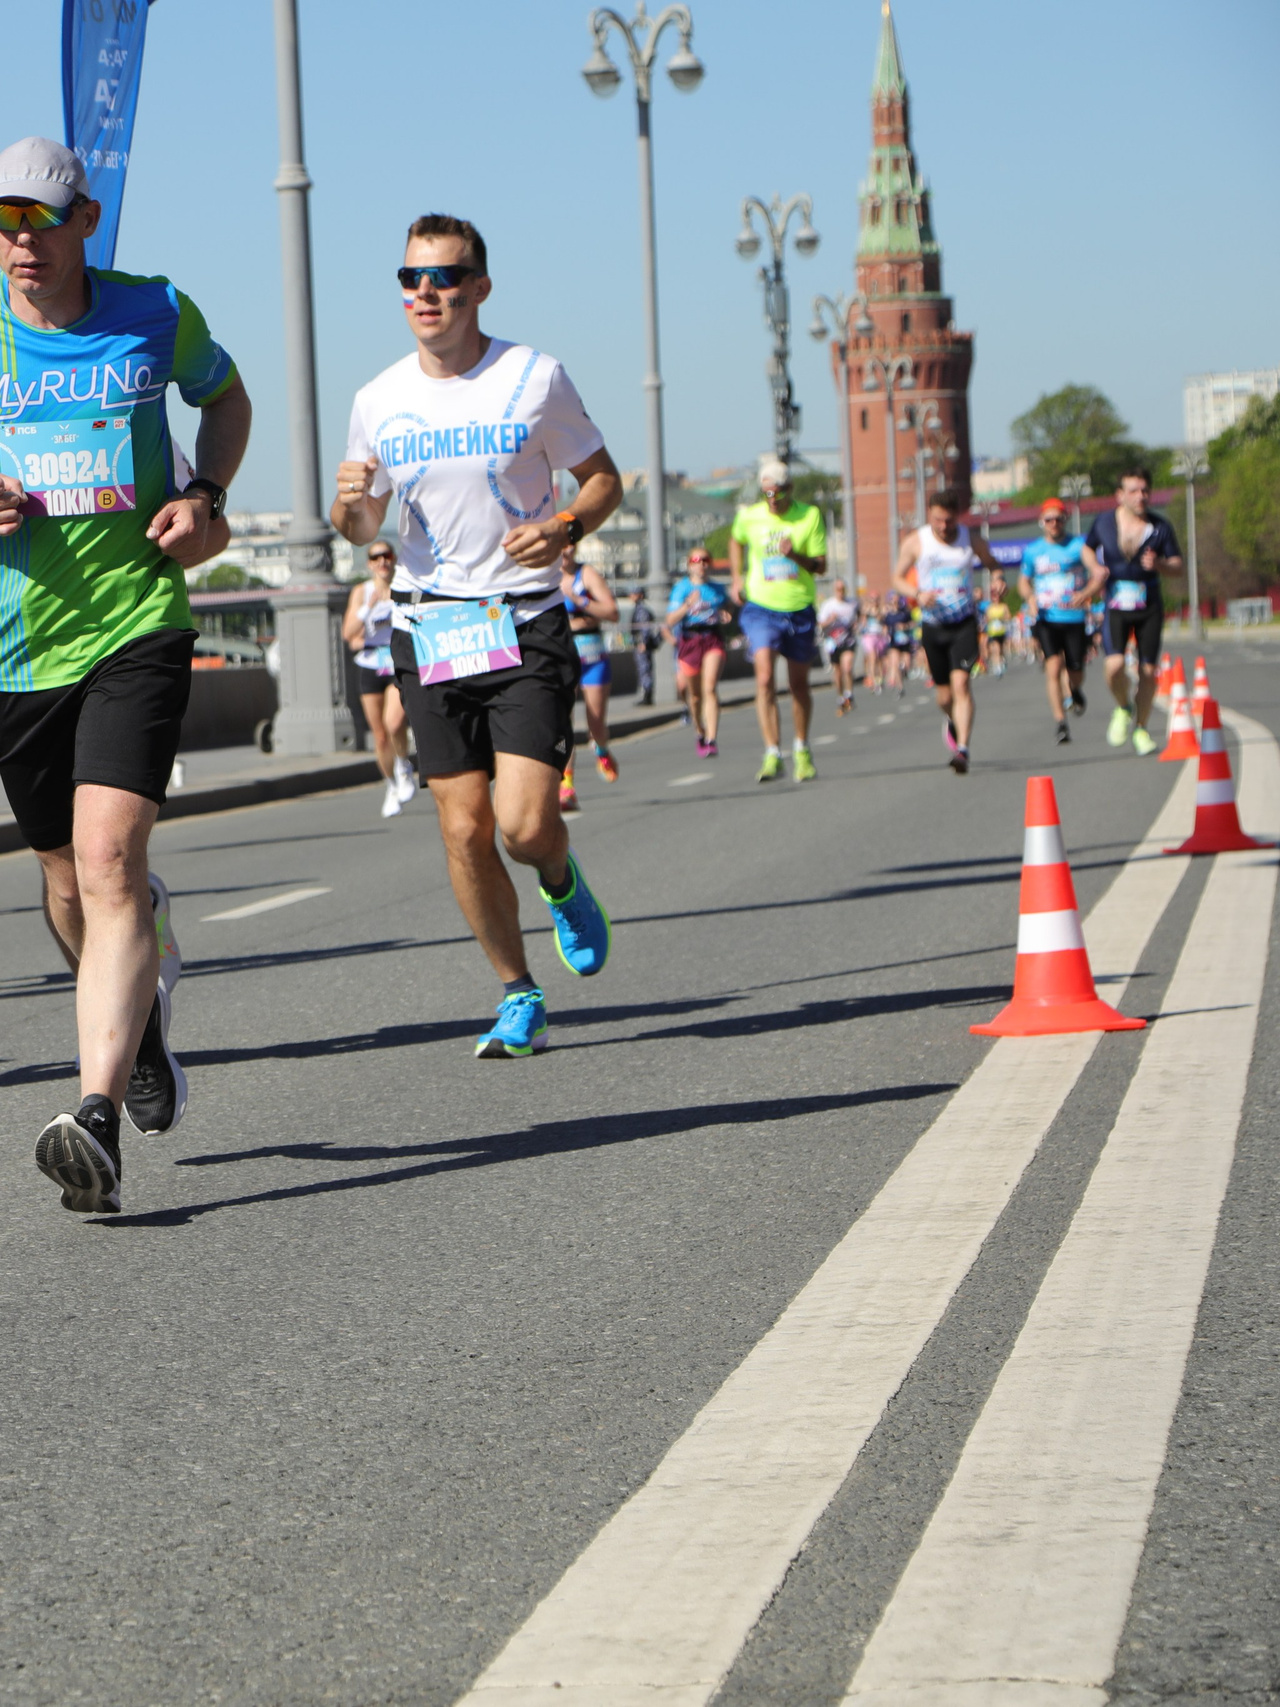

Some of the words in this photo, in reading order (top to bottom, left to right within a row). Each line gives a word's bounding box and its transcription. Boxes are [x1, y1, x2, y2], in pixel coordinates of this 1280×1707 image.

[17, 426, 37, 434] ПСБ
[380, 420, 529, 469] ПЕЙСМЕЙКЕР
[24, 448, 110, 487] 30924
[435, 621, 497, 658] 36271
